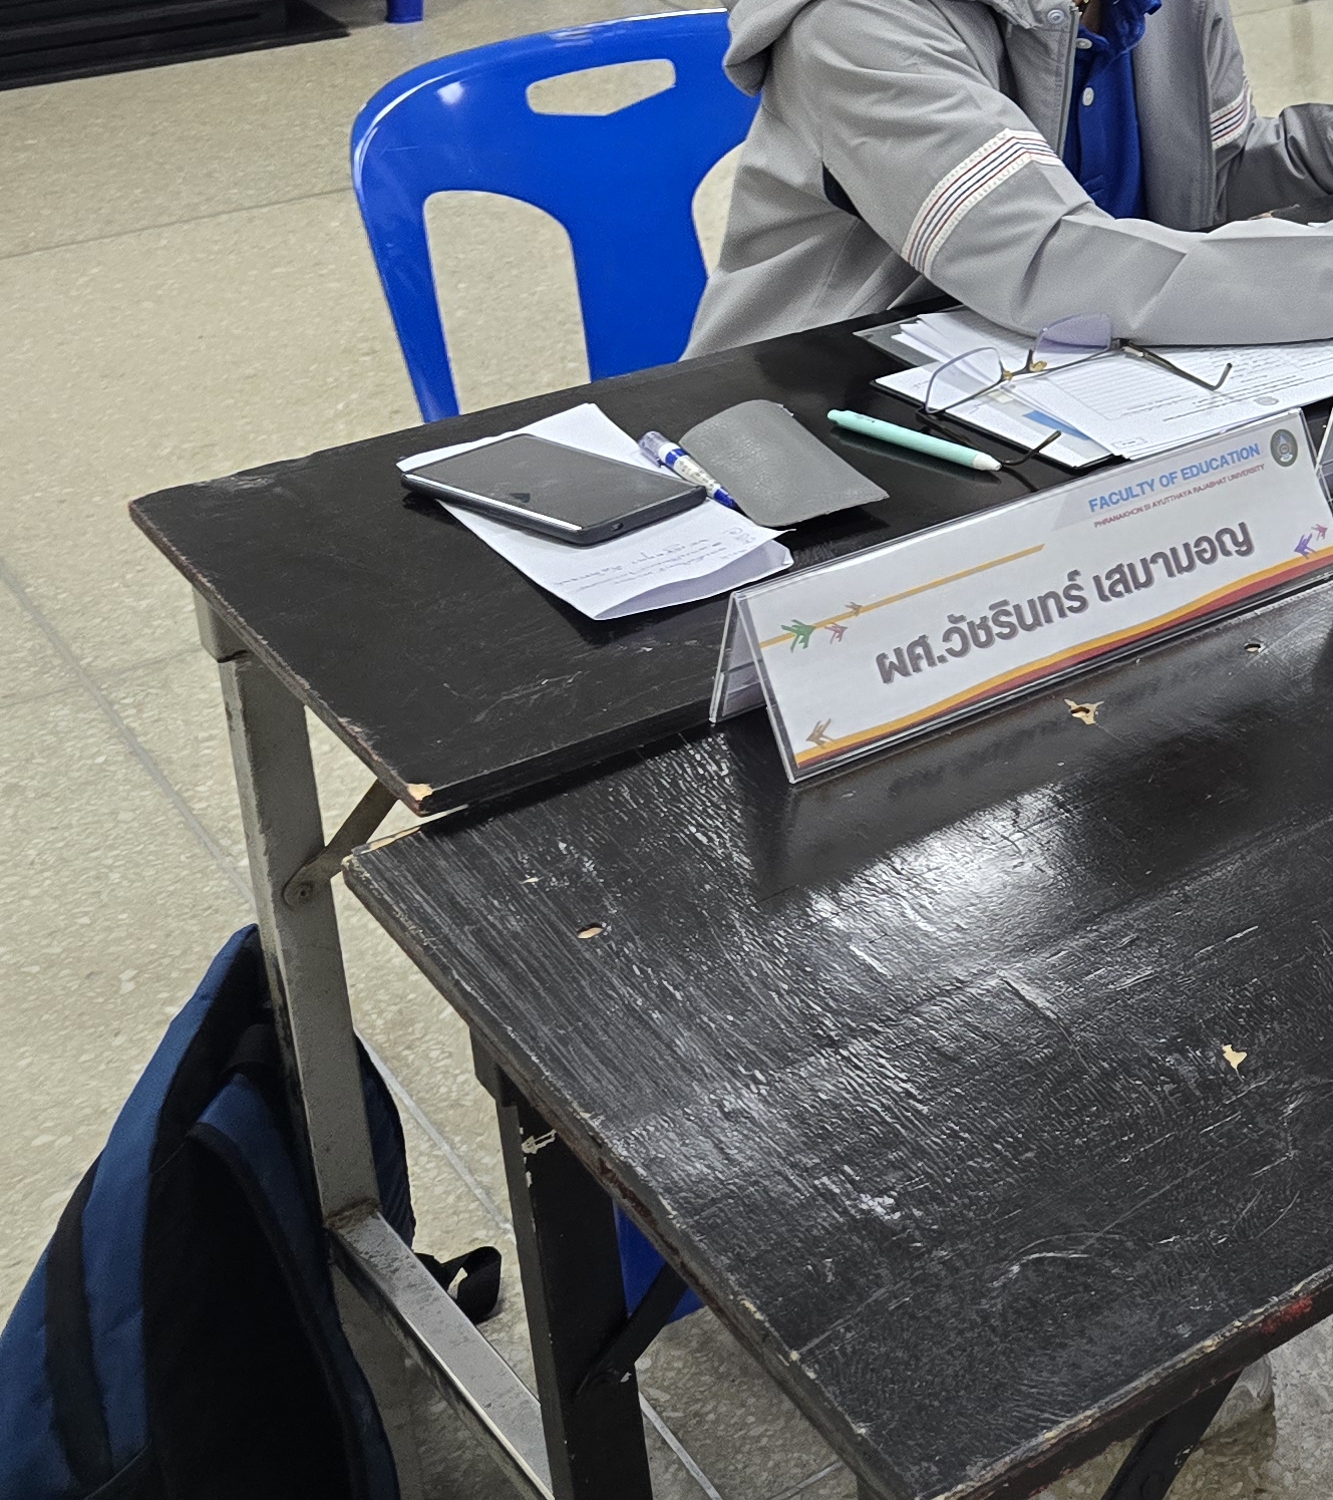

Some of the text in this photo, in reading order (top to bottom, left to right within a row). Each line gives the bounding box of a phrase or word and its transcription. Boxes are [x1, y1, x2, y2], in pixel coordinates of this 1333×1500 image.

[1088, 443, 1261, 513] FACULTY OF EDUCATION
[1094, 505, 1144, 528] PHRANAKHON
[1151, 489, 1193, 509] AYUTTHAYA
[1193, 476, 1227, 494] RAJABHAT
[1227, 463, 1266, 483] UNIVERSITY
[875, 521, 1255, 684] ผศ.วัชรินทร์ เสมามอญ
